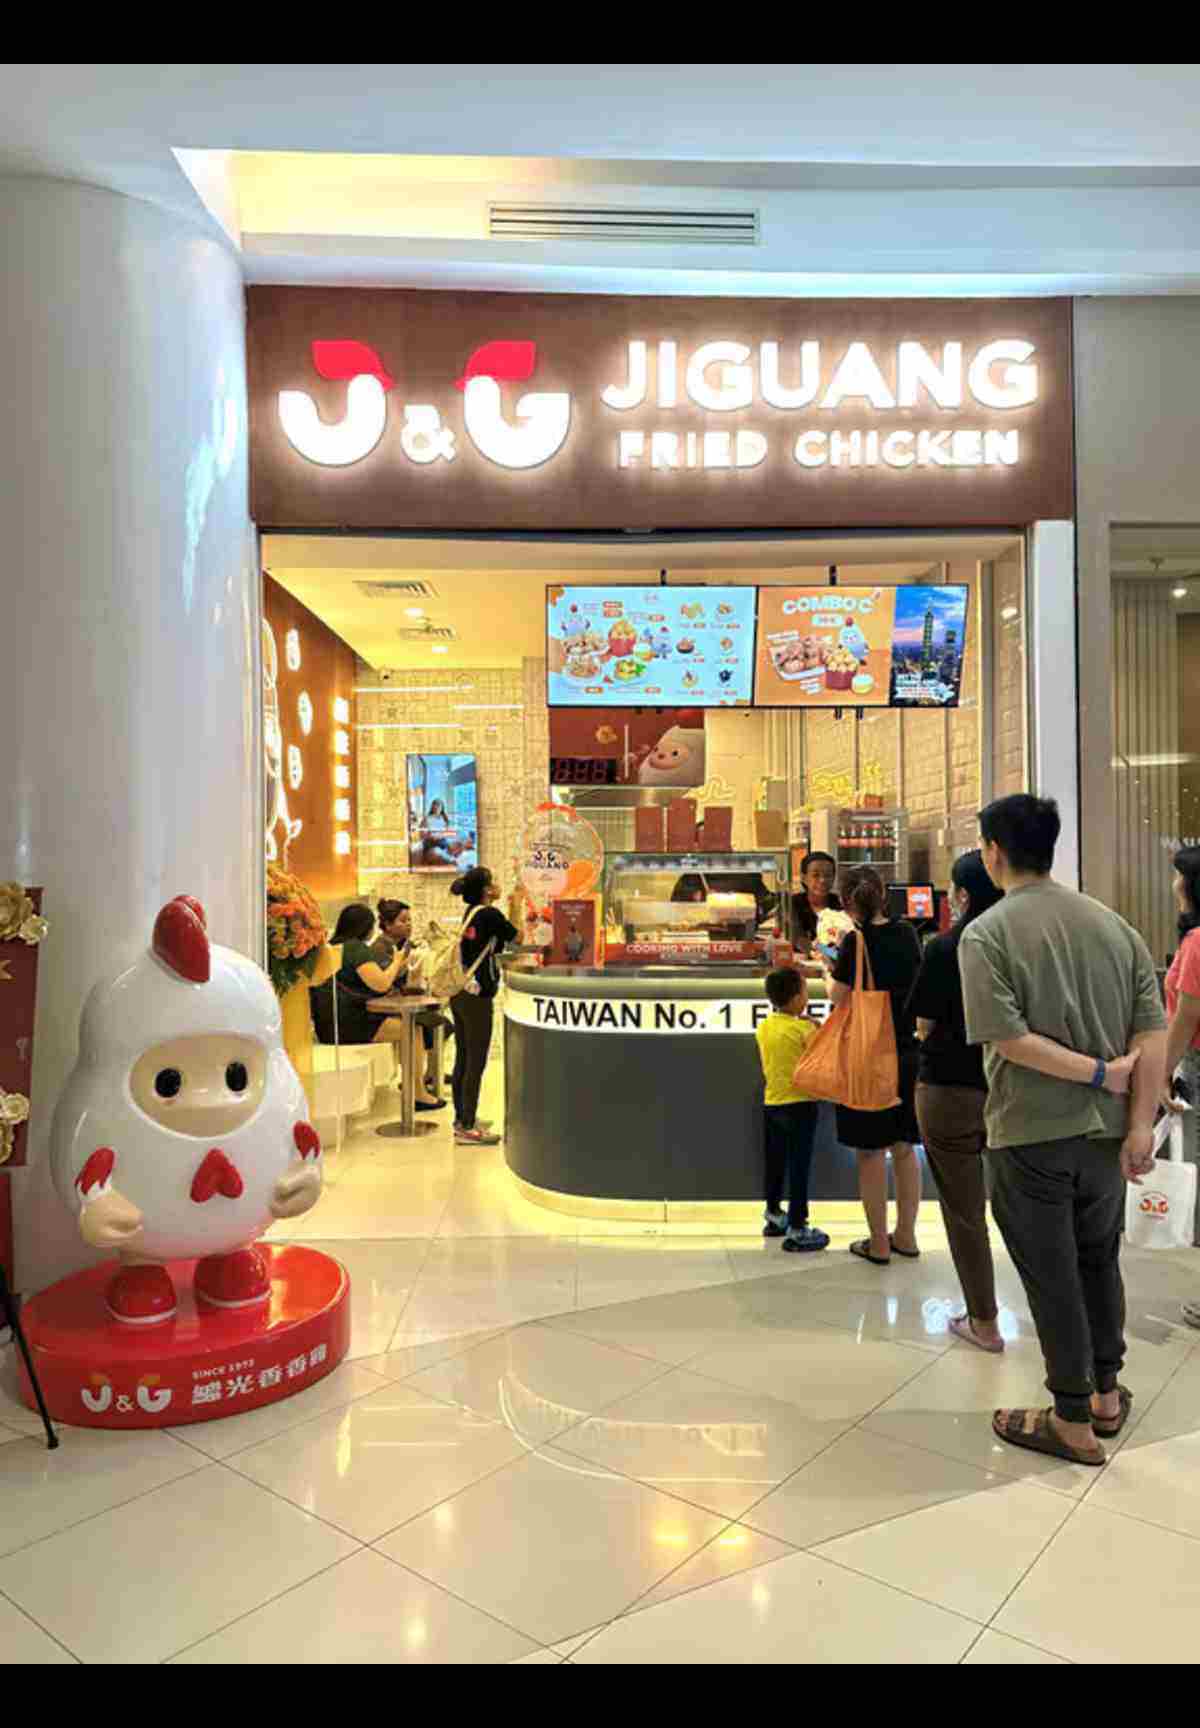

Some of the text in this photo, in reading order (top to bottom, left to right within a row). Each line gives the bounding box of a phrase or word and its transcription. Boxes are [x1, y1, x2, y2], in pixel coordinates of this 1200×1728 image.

[600, 339, 1039, 411] JIGUANG
[278, 355, 571, 470] J&G
[619, 430, 1019, 468] FRIED CHICKEN
[783, 595, 857, 615] COMBO
[626, 943, 741, 954] COOKING WITH LOVE
[533, 998, 642, 1029] TAIWAN
[655, 1003, 706, 1029] No.
[719, 1003, 732, 1029] 1
[192, 1365, 226, 1380] SINCE
[81, 1380, 172, 1413] J&G
